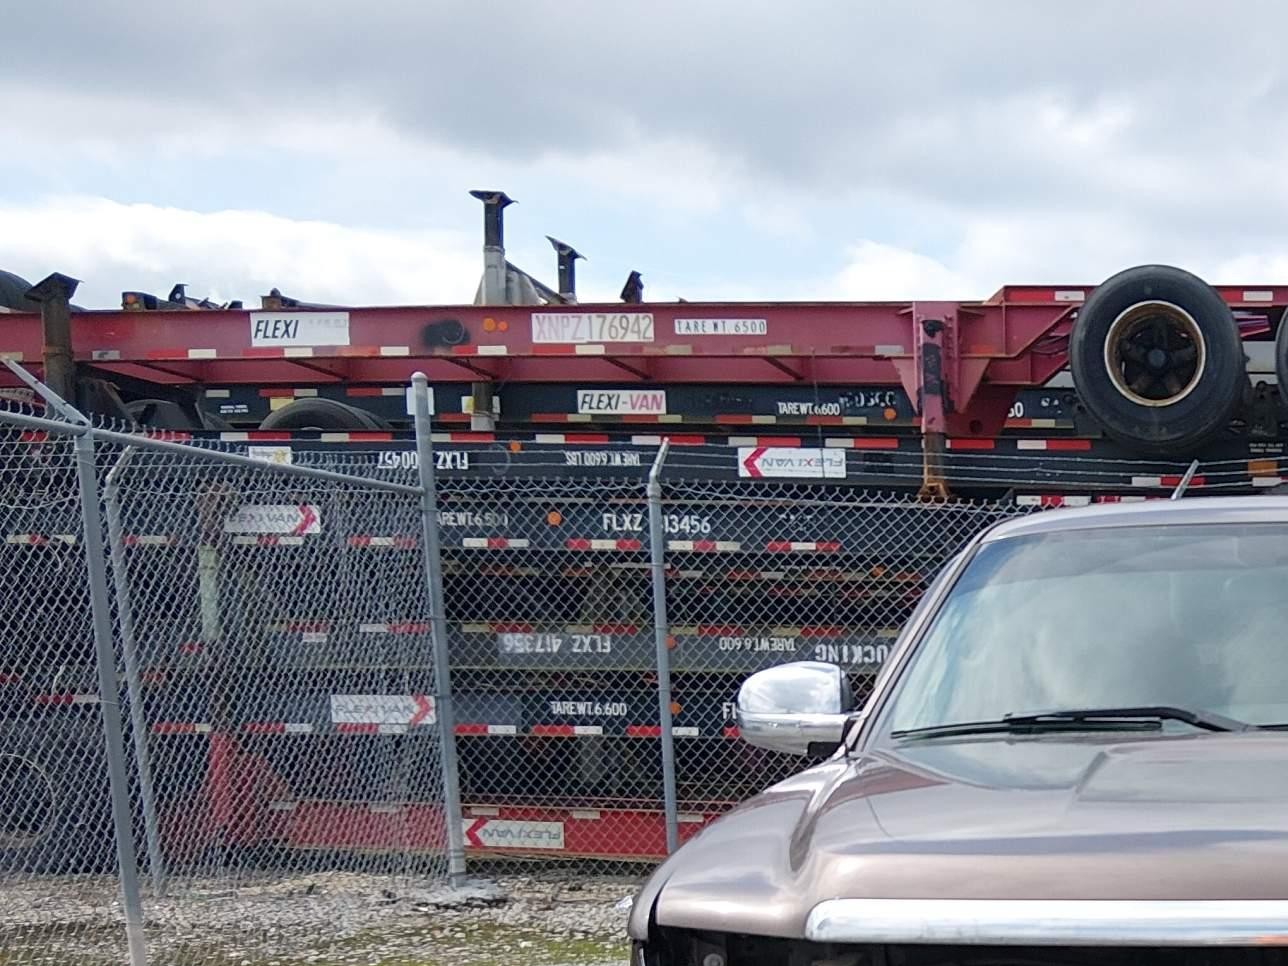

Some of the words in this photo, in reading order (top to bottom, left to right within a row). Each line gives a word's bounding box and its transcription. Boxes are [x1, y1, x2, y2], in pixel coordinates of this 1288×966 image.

[253, 319, 299, 339] FLEXI
[676, 320, 707, 333] TARE
[734, 320, 766, 333] 6500
[579, 392, 664, 411] FLEXI-VAN
[436, 451, 470, 470] FLXZ
[760, 457, 794, 468] VAN
[800, 457, 844, 468] FLEXI
[602, 512, 644, 532] FLXZ
[662, 513, 712, 534] 13456
[572, 634, 612, 653] FLXZ
[814, 644, 889, 664] UCKING
